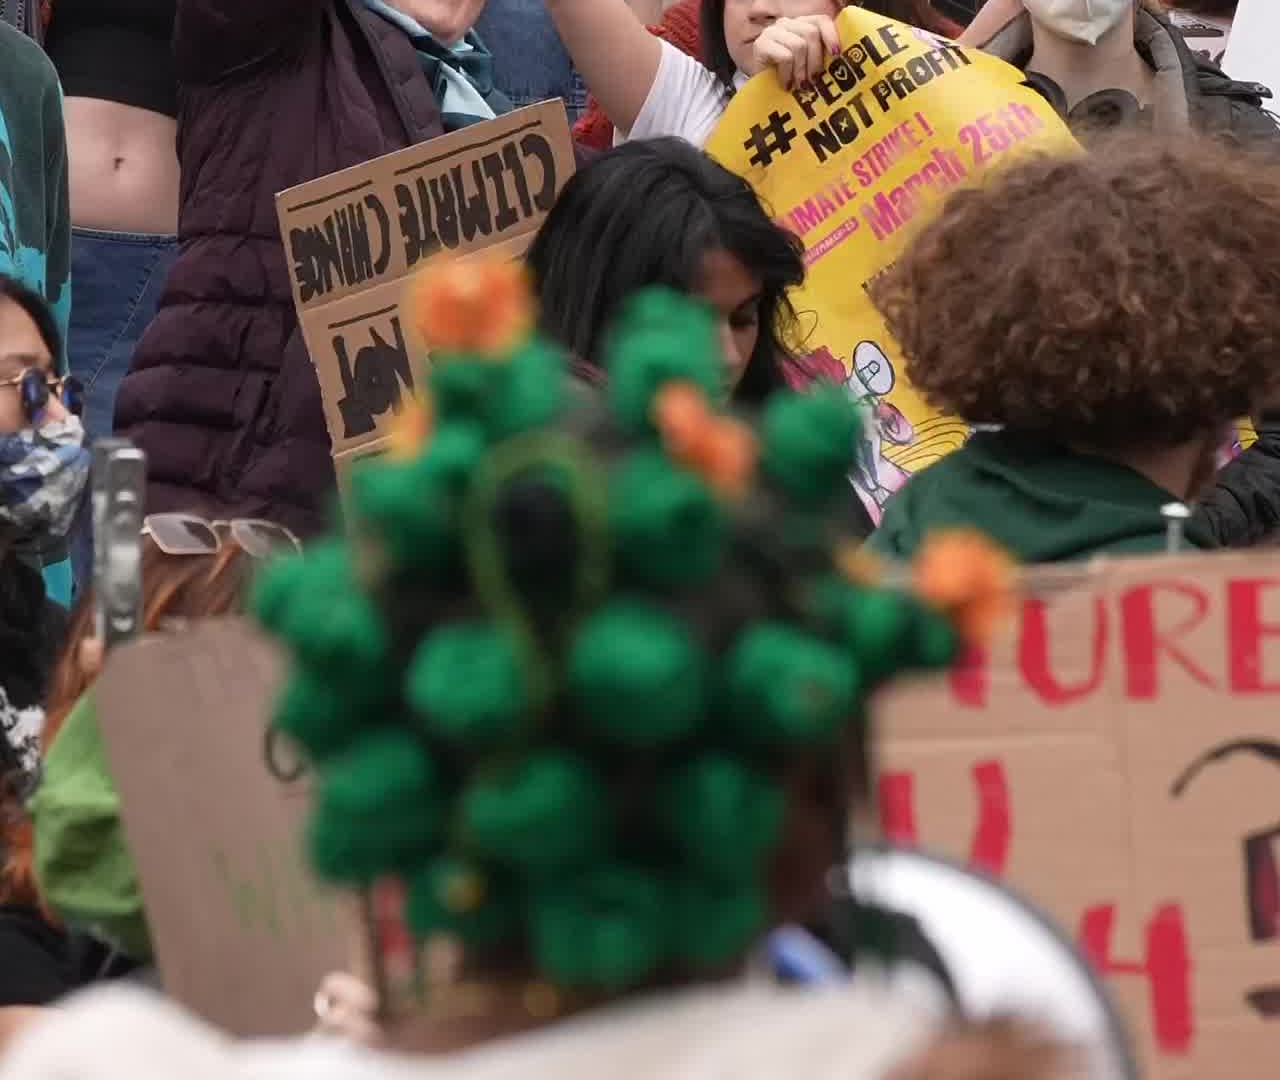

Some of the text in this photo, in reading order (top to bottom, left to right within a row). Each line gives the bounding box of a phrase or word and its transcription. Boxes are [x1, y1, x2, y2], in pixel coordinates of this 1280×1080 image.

[802, 40, 973, 164] NOT PROFIT
[289, 132, 558, 304] CLIMATE CHANGE
[859, 146, 968, 242] March
